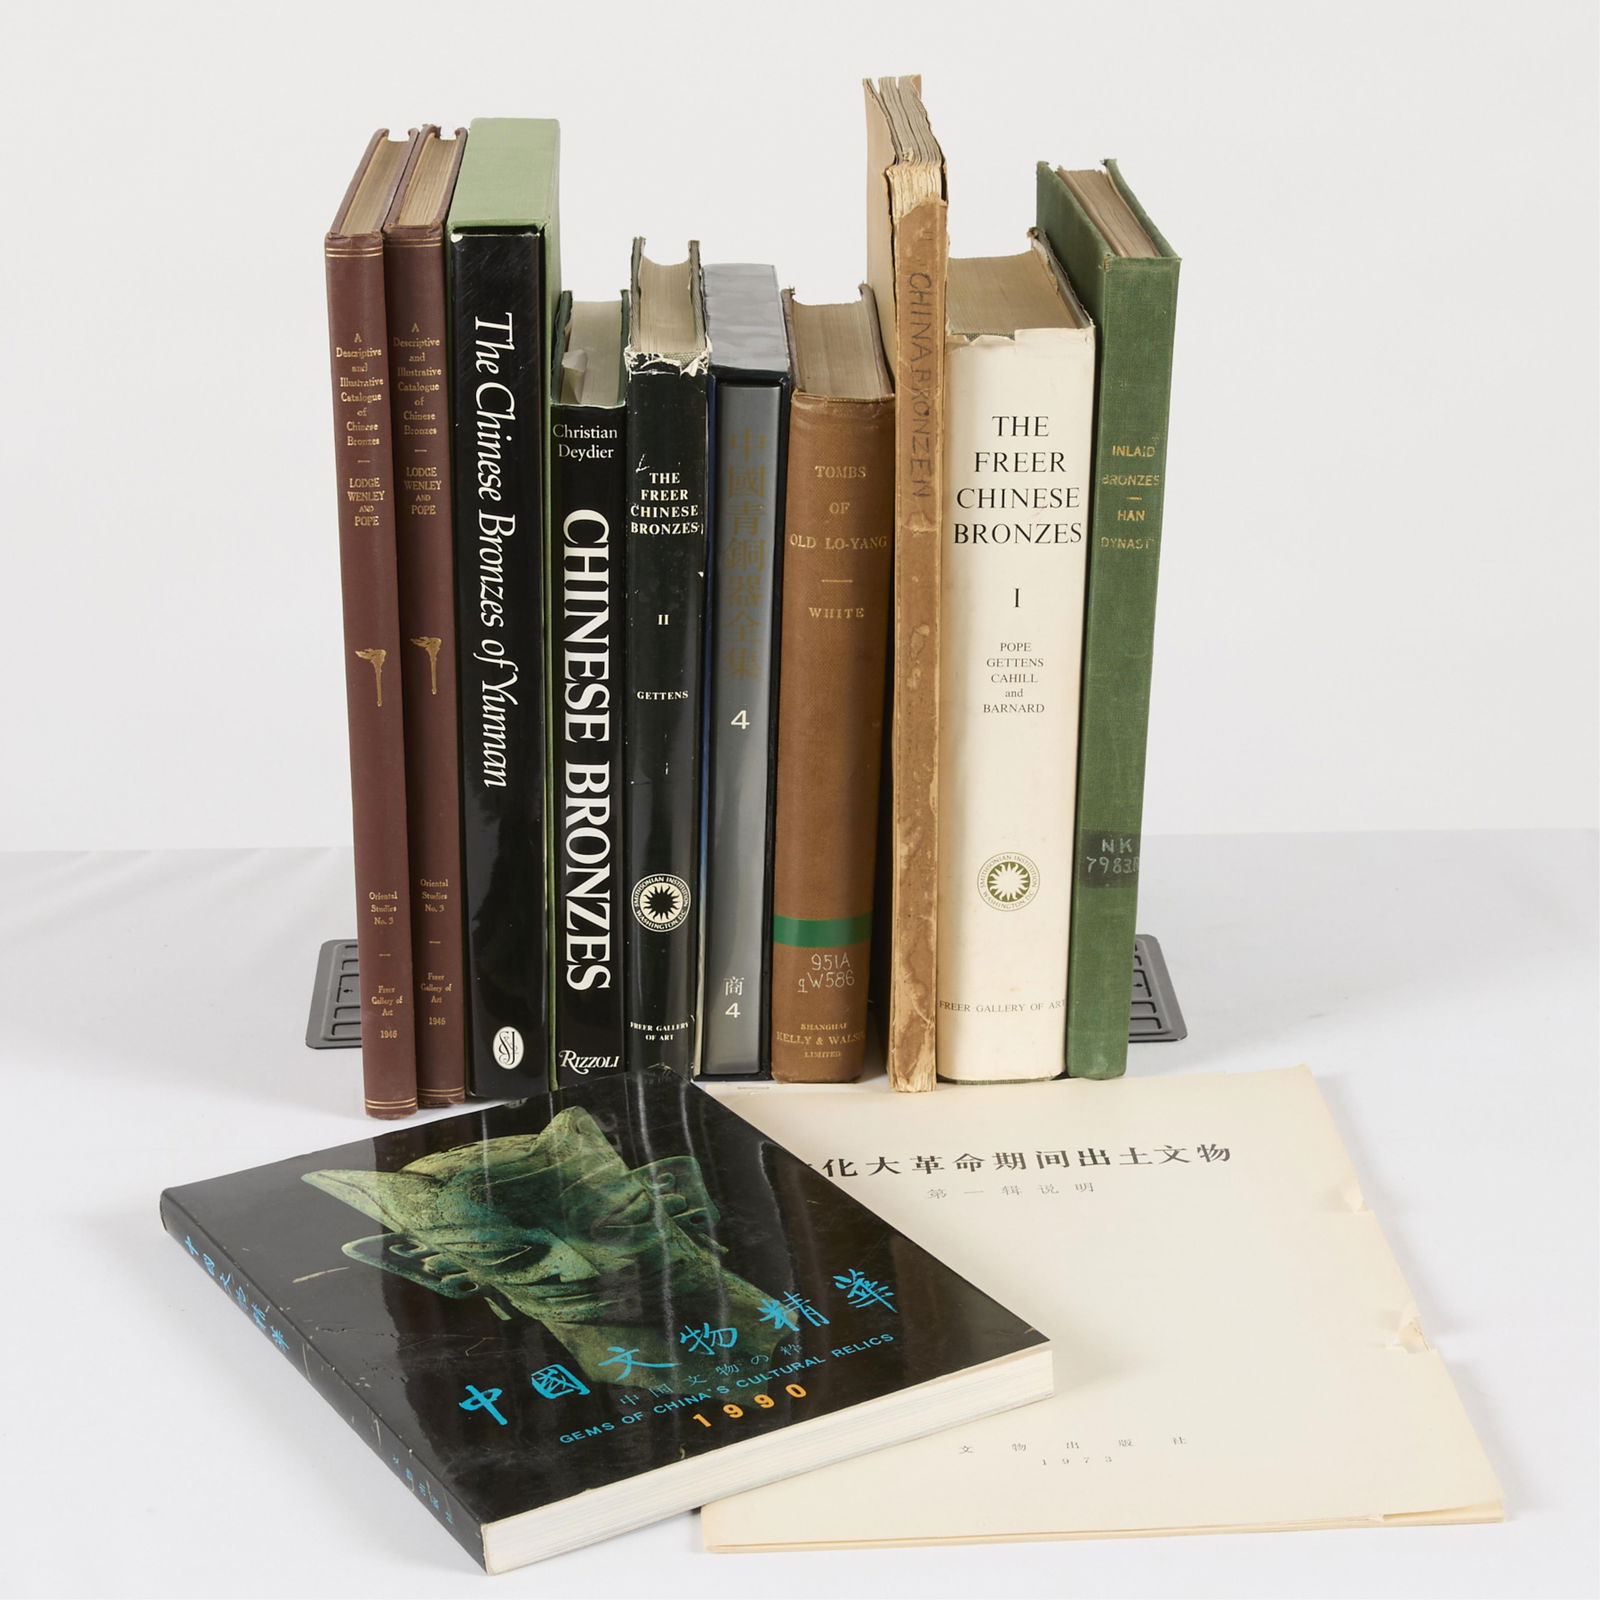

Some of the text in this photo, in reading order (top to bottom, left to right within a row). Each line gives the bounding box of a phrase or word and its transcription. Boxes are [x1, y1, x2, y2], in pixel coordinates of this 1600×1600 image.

[411, 322, 420, 333] A
[354, 332, 362, 343] A
[393, 337, 441, 349] Descriptive
[335, 346, 382, 360] Descriptive
[409, 352, 426, 362] and
[352, 362, 368, 373] and
[397, 366, 442, 377] Illustrative
[340, 376, 384, 388] Illustrative
[398, 382, 440, 393] Catalogue
[341, 391, 382, 403] Catalogue
[414, 396, 425, 406] of
[356, 407, 368, 417] of
[403, 410, 436, 421] Chinese
[346, 421, 379, 432] Chinese
[404, 424, 438, 435] Bronzes
[552, 424, 618, 440] Christian
[991, 415, 1050, 438] THE
[347, 435, 380, 446] Bronzes
[558, 443, 614, 462] Deydier
[1112, 445, 1155, 457] INLAID
[974, 451, 1067, 473] FREER
[406, 467, 438, 478] LODGE
[649, 472, 681, 484] THE
[814, 465, 867, 479] TOMBS
[349, 477, 380, 489] LODGE
[404, 479, 442, 491] WENLEY
[1102, 474, 1160, 486] BRONZES
[346, 490, 385, 502] WENLEY
[415, 494, 431, 502] AND
[640, 489, 689, 501] FREER
[956, 486, 1080, 510] CHINESE
[358, 504, 375, 513] AND
[411, 504, 437, 515] POPE
[630, 504, 699, 518] CHINESE
[829, 502, 850, 515] OF
[354, 515, 380, 527] POPE
[1117, 509, 1146, 522] HAN
[630, 521, 700, 535] BRONZES
[953, 522, 1082, 546] BRONZES
[790, 533, 888, 550] OLD LO-YANG
[1100, 536, 1156, 550] DYNAST
[473, 312, 520, 788] The Chinese Bronzes of Yunnan
[724, 427, 769, 681] 中國青銅器全集
[1014, 587, 1021, 609] I
[808, 607, 865, 619] WHITE
[657, 614, 670, 626] II
[999, 642, 1032, 653] POPE
[986, 657, 1044, 668] GETTENS
[990, 673, 1039, 684] CAHILL
[636, 690, 689, 701] GETTENS
[1005, 688, 1024, 699] and
[983, 703, 1045, 714] BARNARD
[731, 710, 750, 730] 4
[563, 509, 612, 991] CHINESE BRONZES
[980, 855, 1012, 888] SMITHSONIAN
[1014, 855, 1037, 888] INSTITUTION
[420, 878, 449, 887] Oriental
[369, 890, 398, 900] Oriental
[421, 891, 448, 900] Studies
[634, 876, 665, 907] SMITHSONIAN
[665, 876, 689, 907] INSTITUTION
[983, 891, 1025, 909] WASHINGTON
[370, 904, 397, 913] Studies
[636, 909, 679, 930] WASHINGTON
[427, 972, 445, 981] Freer
[378, 985, 395, 994] Freer
[420, 982, 452, 993] Gallery of
[723, 976, 745, 997] 商
[371, 994, 403, 1006] Gallery of
[431, 995, 442, 1003] Art
[381, 1008, 394, 1017] Art
[725, 1002, 741, 1019] 4
[938, 1000, 971, 1013] FREER
[975, 1003, 1025, 1013] GALLERY
[1030, 1002, 1042, 1012] OF
[428, 1016, 446, 1025] 1946
[630, 1021, 689, 1032] FREER GALLERY
[800, 1022, 847, 1031] SHANGHAI
[380, 1030, 398, 1039] 1946
[776, 1031, 812, 1045] KELLY
[815, 1036, 824, 1046] &
[558, 1050, 620, 1074] RIZZOLI
[807, 1142, 1231, 1178] 化大革命期间出土文物
[559, 1332, 895, 1444] GEMS OF CHINA'S CULTURAL RELICS
[692, 1382, 808, 1429] 1990
